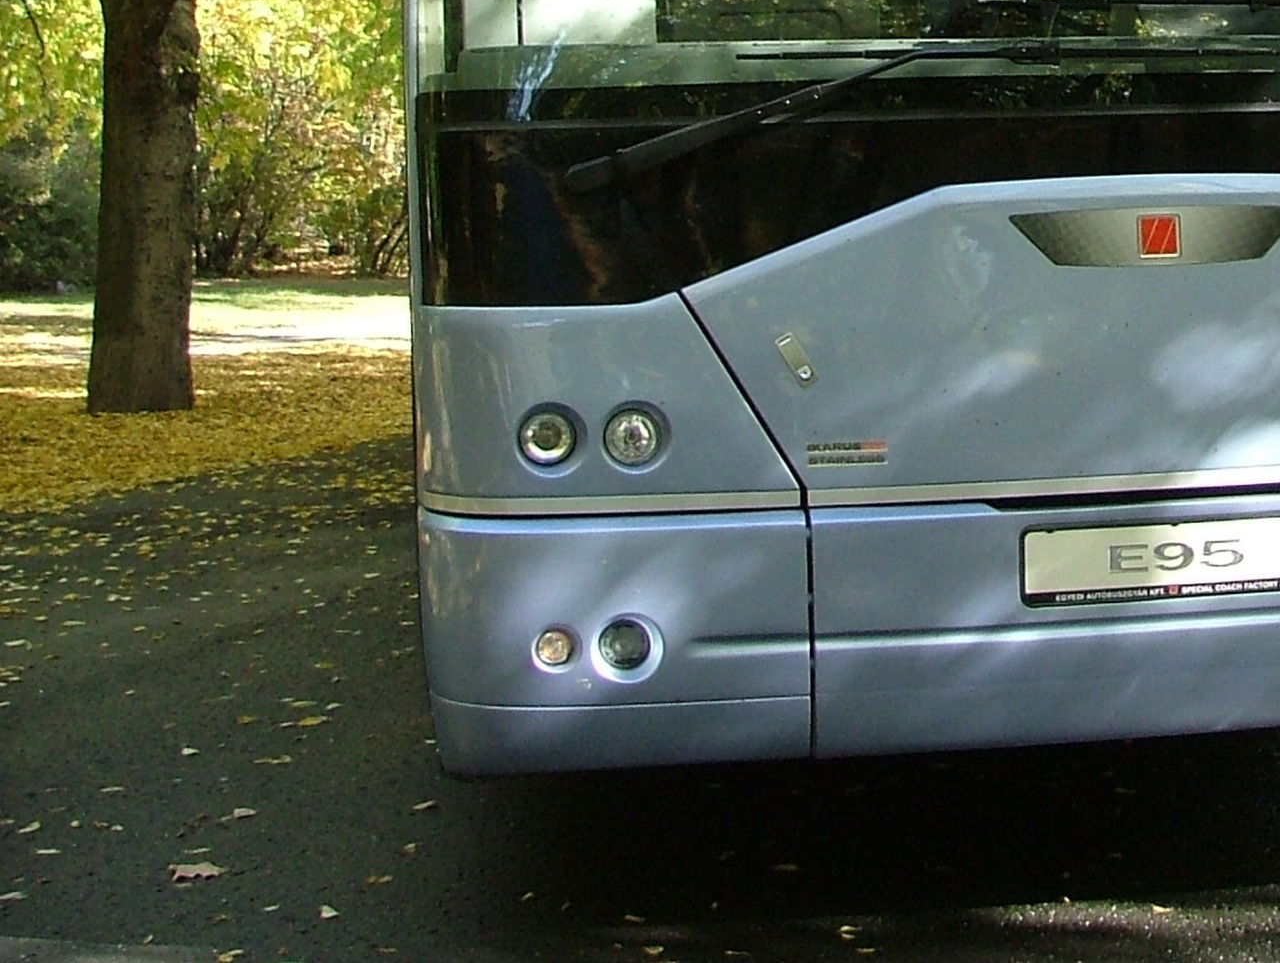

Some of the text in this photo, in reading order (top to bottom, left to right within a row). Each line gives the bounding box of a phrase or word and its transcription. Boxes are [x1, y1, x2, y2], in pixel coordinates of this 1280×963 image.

[807, 441, 860, 452] IKARUS
[1108, 538, 1244, 574] E95
[1181, 584, 1213, 594] SPECIAL
[1215, 582, 1243, 592] COACH
[1244, 580, 1279, 590] FACTORY
